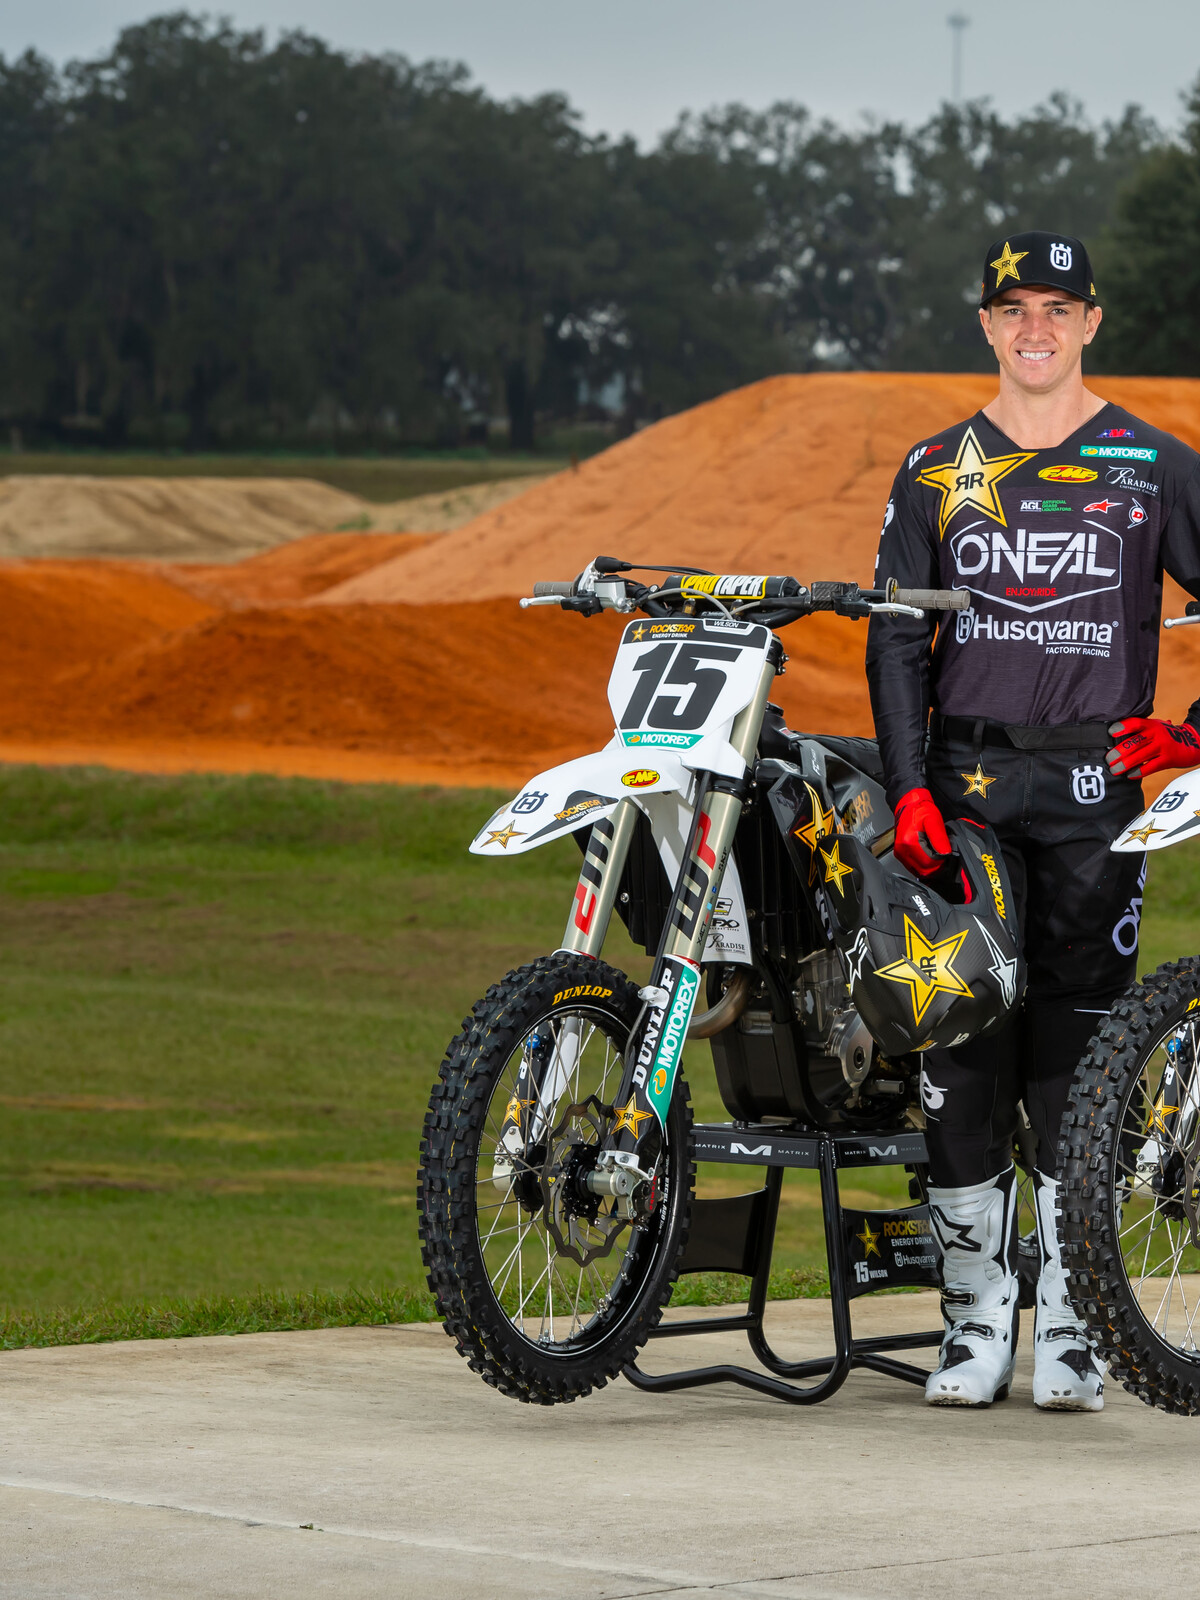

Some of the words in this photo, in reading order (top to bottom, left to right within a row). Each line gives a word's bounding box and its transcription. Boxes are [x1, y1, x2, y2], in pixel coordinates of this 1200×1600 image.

[1098, 447, 1153, 460] MOTOREX
[1039, 468, 1098, 479] FMF
[1020, 501, 1041, 510] AGL
[1005, 587, 1034, 597] ENJOY
[650, 624, 696, 634] ROCKSTAR
[713, 620, 739, 628] WILSON
[1045, 646, 1082, 656] FACTORY
[1082, 648, 1110, 658] RACING
[620, 643, 743, 730] 15
[641, 733, 692, 746] MOTOREX
[623, 771, 658, 786] FMF
[555, 800, 601, 821] ROCKSTAR
[566, 810, 587, 822] ENERGY
[586, 804, 604, 815] DRINK
[981, 853, 1006, 919] ROCKSTAR
[552, 985, 614, 1006] DUNLOP
[657, 978, 696, 1069] MOTOREX
[891, 1238, 914, 1246] ENERGY
[914, 1236, 933, 1245] DRINK
[903, 1255, 936, 1266] Husqvarna
[854, 1261, 870, 1283] 15
[869, 1269, 888, 1279] WILSON
